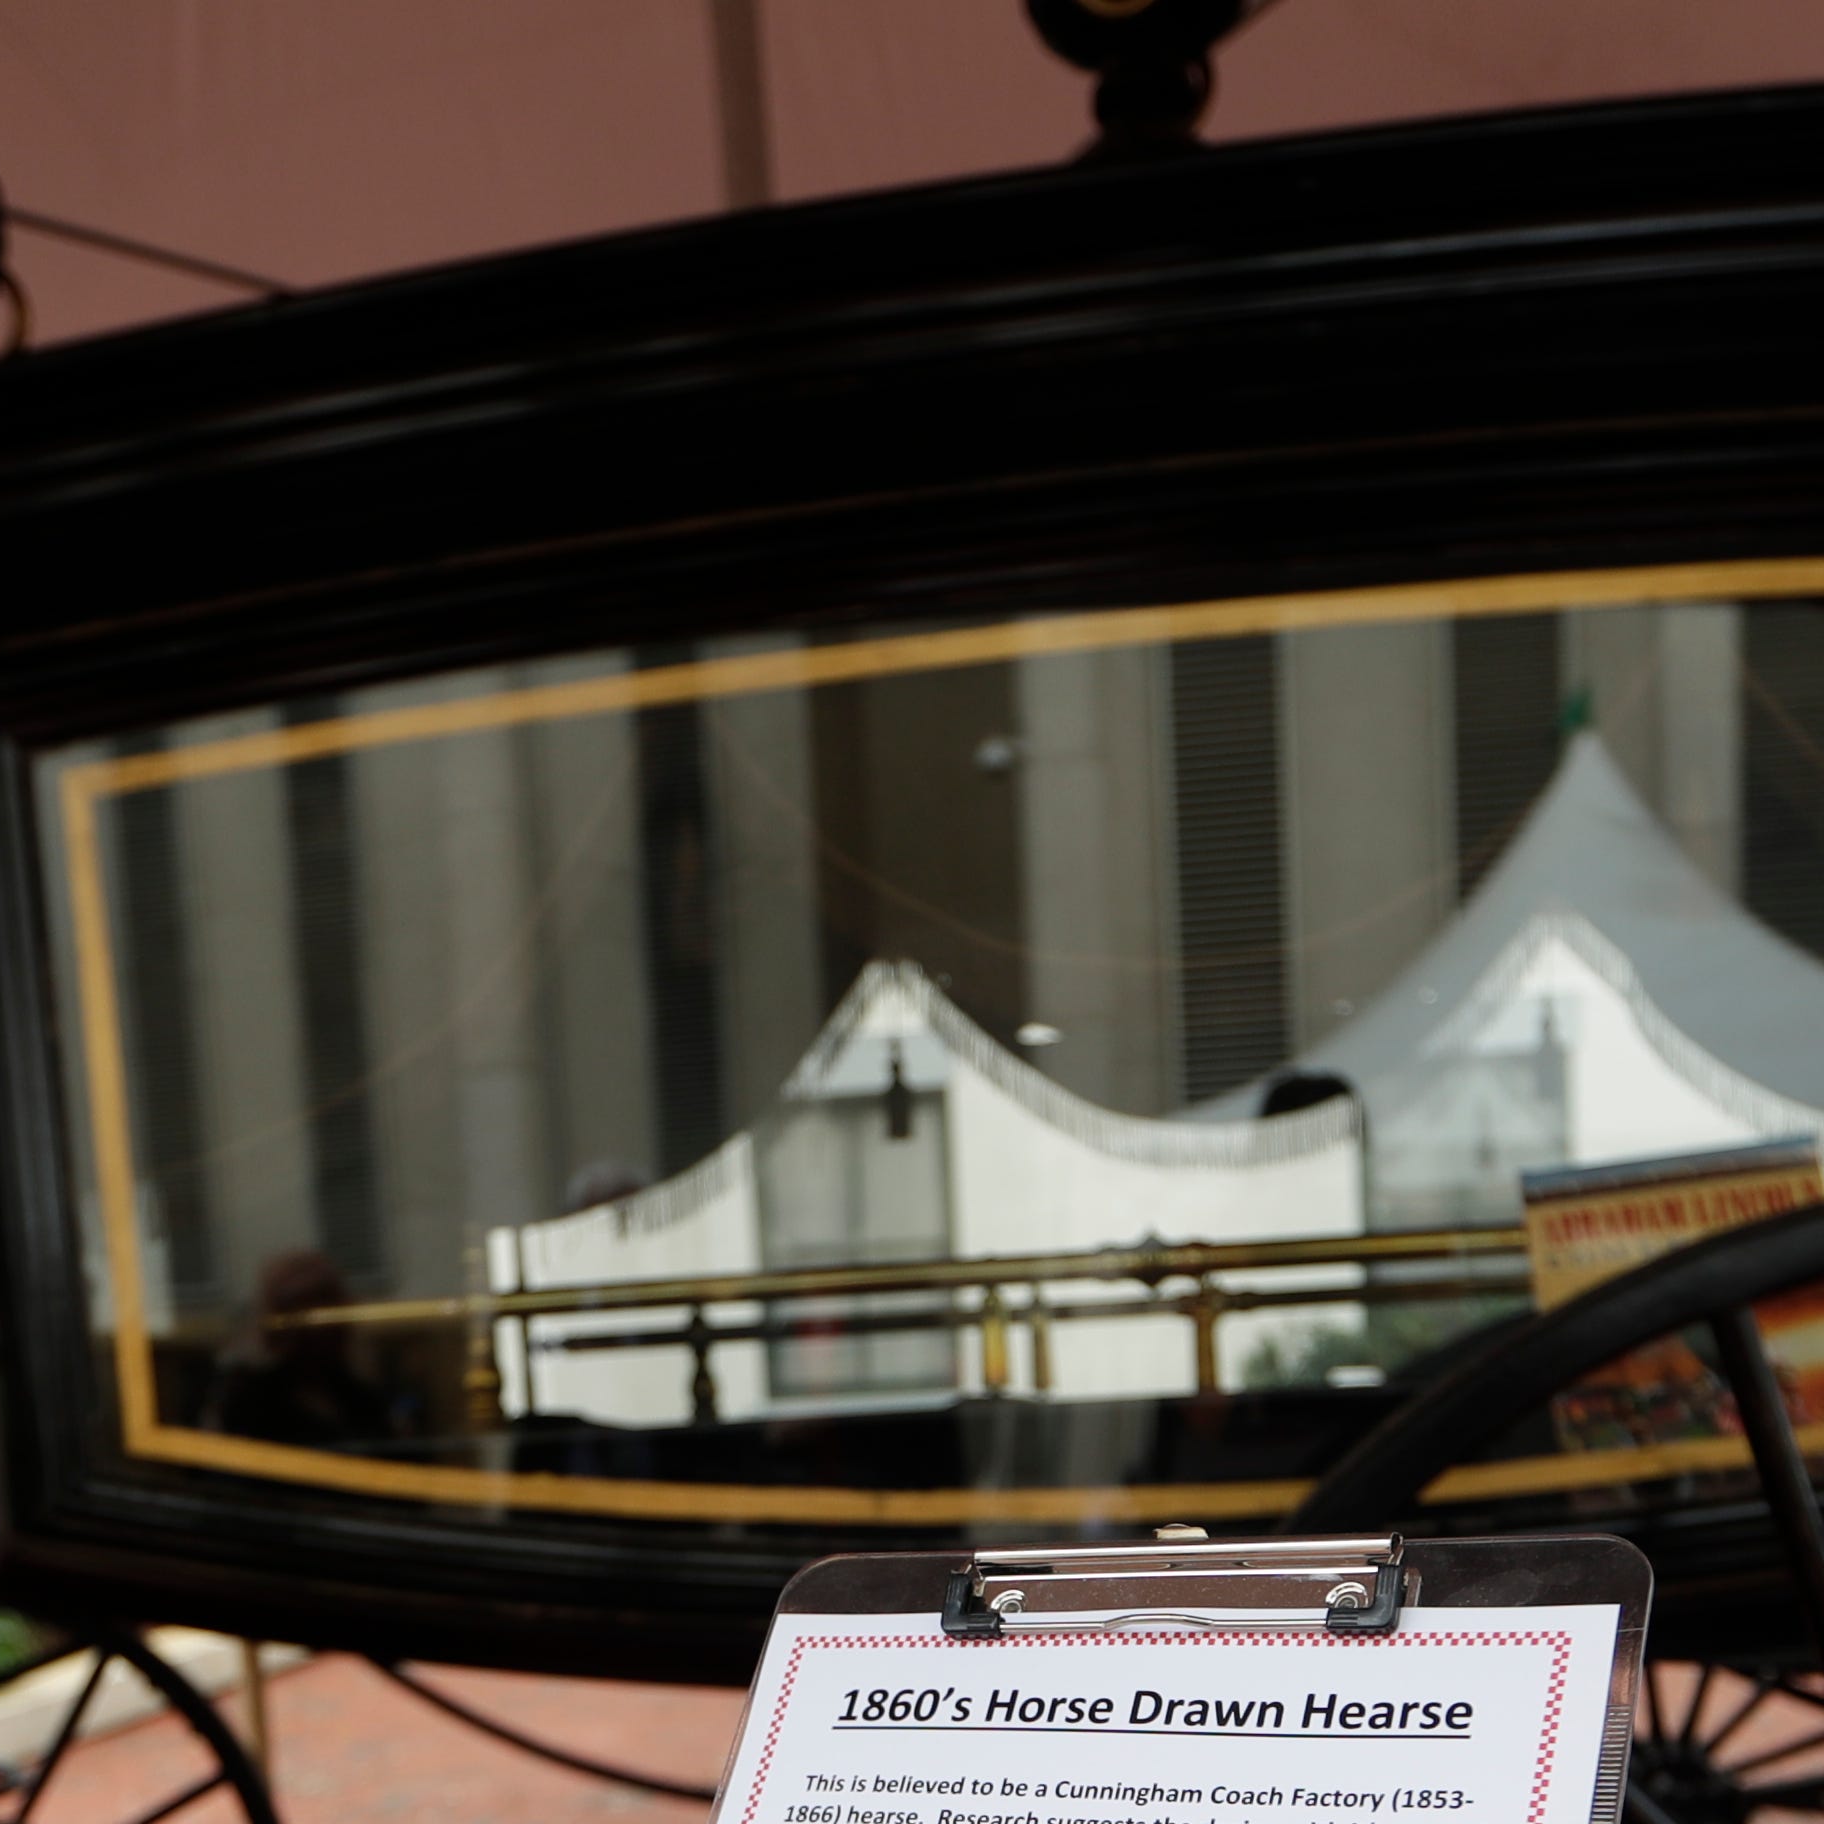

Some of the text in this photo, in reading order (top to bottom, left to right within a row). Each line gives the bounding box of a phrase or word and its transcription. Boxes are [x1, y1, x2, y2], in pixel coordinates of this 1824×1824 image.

[983, 1688, 1115, 1725] Horse
[1127, 1689, 1285, 1729] Drawn
[1300, 1692, 1475, 1731] Hearse
[805, 1773, 1475, 1814] This is believed to be a Cunningham Coach Factory (1853-
